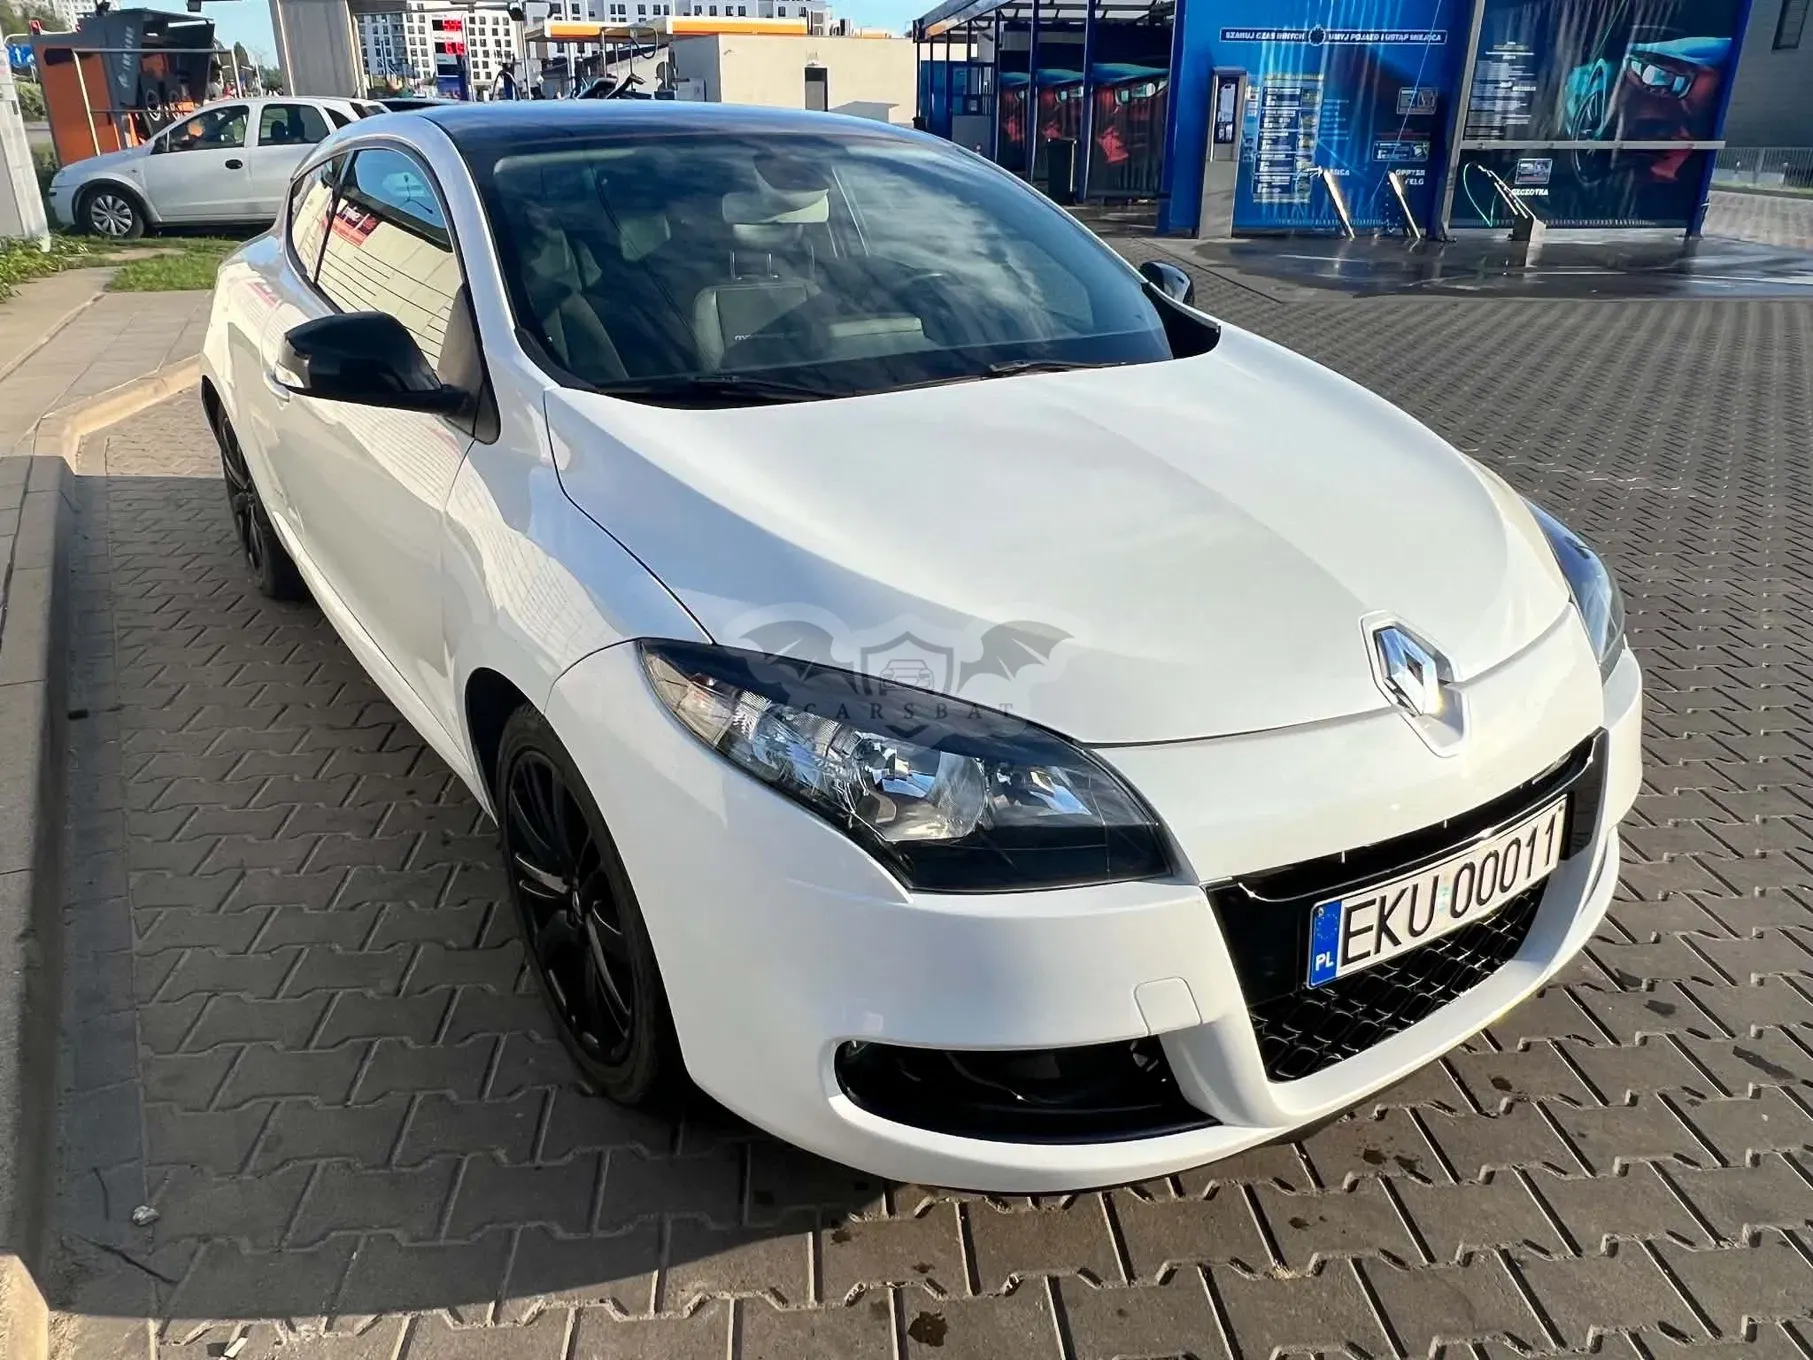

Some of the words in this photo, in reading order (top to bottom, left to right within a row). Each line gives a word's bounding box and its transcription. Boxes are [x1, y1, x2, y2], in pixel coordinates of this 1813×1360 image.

[1340, 875, 1440, 968] EKU
[1450, 813, 1557, 919] 00011
[1315, 953, 1335, 972] PL
